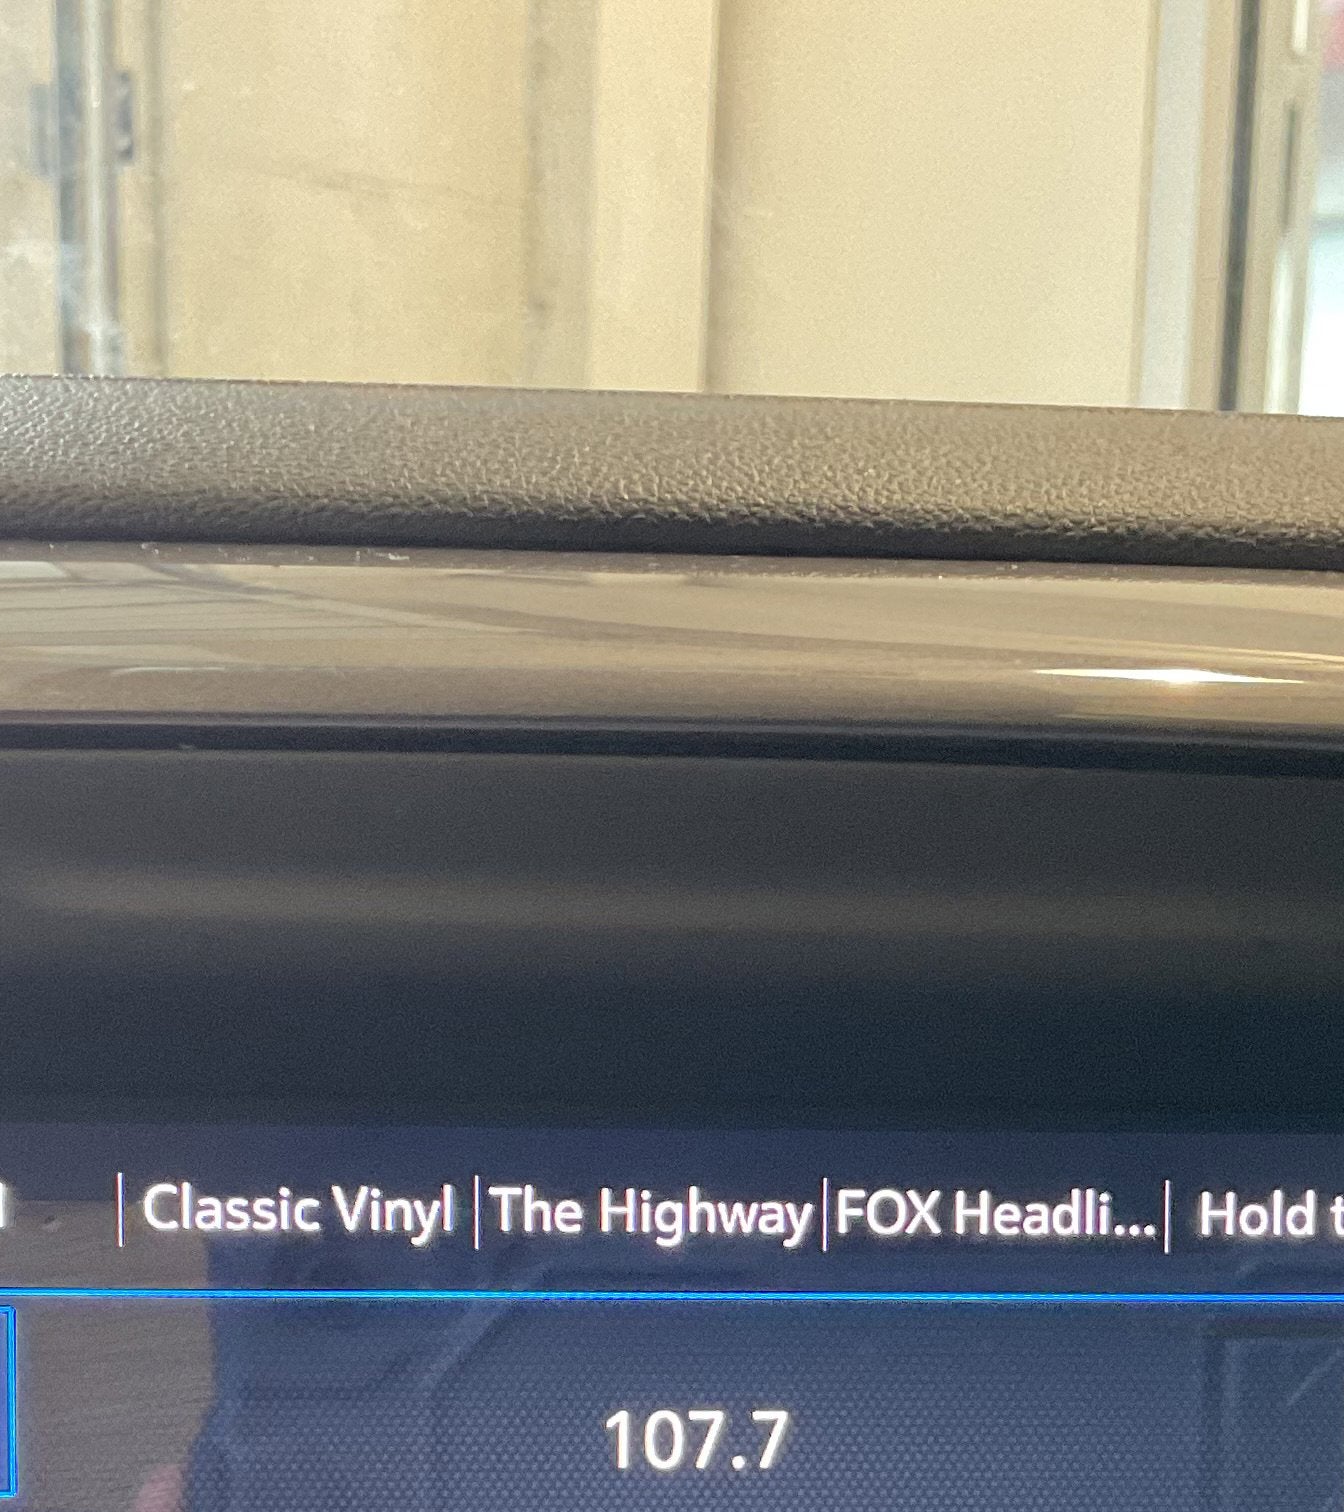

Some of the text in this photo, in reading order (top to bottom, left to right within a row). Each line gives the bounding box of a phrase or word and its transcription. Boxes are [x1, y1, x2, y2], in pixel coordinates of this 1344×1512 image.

[143, 1182, 453, 1247] Classic Vinyl
[488, 1185, 814, 1248] The Highway
[838, 1189, 941, 1236] FOX
[1201, 1190, 1316, 1238] Hold
[606, 1410, 788, 1471] 107.7
